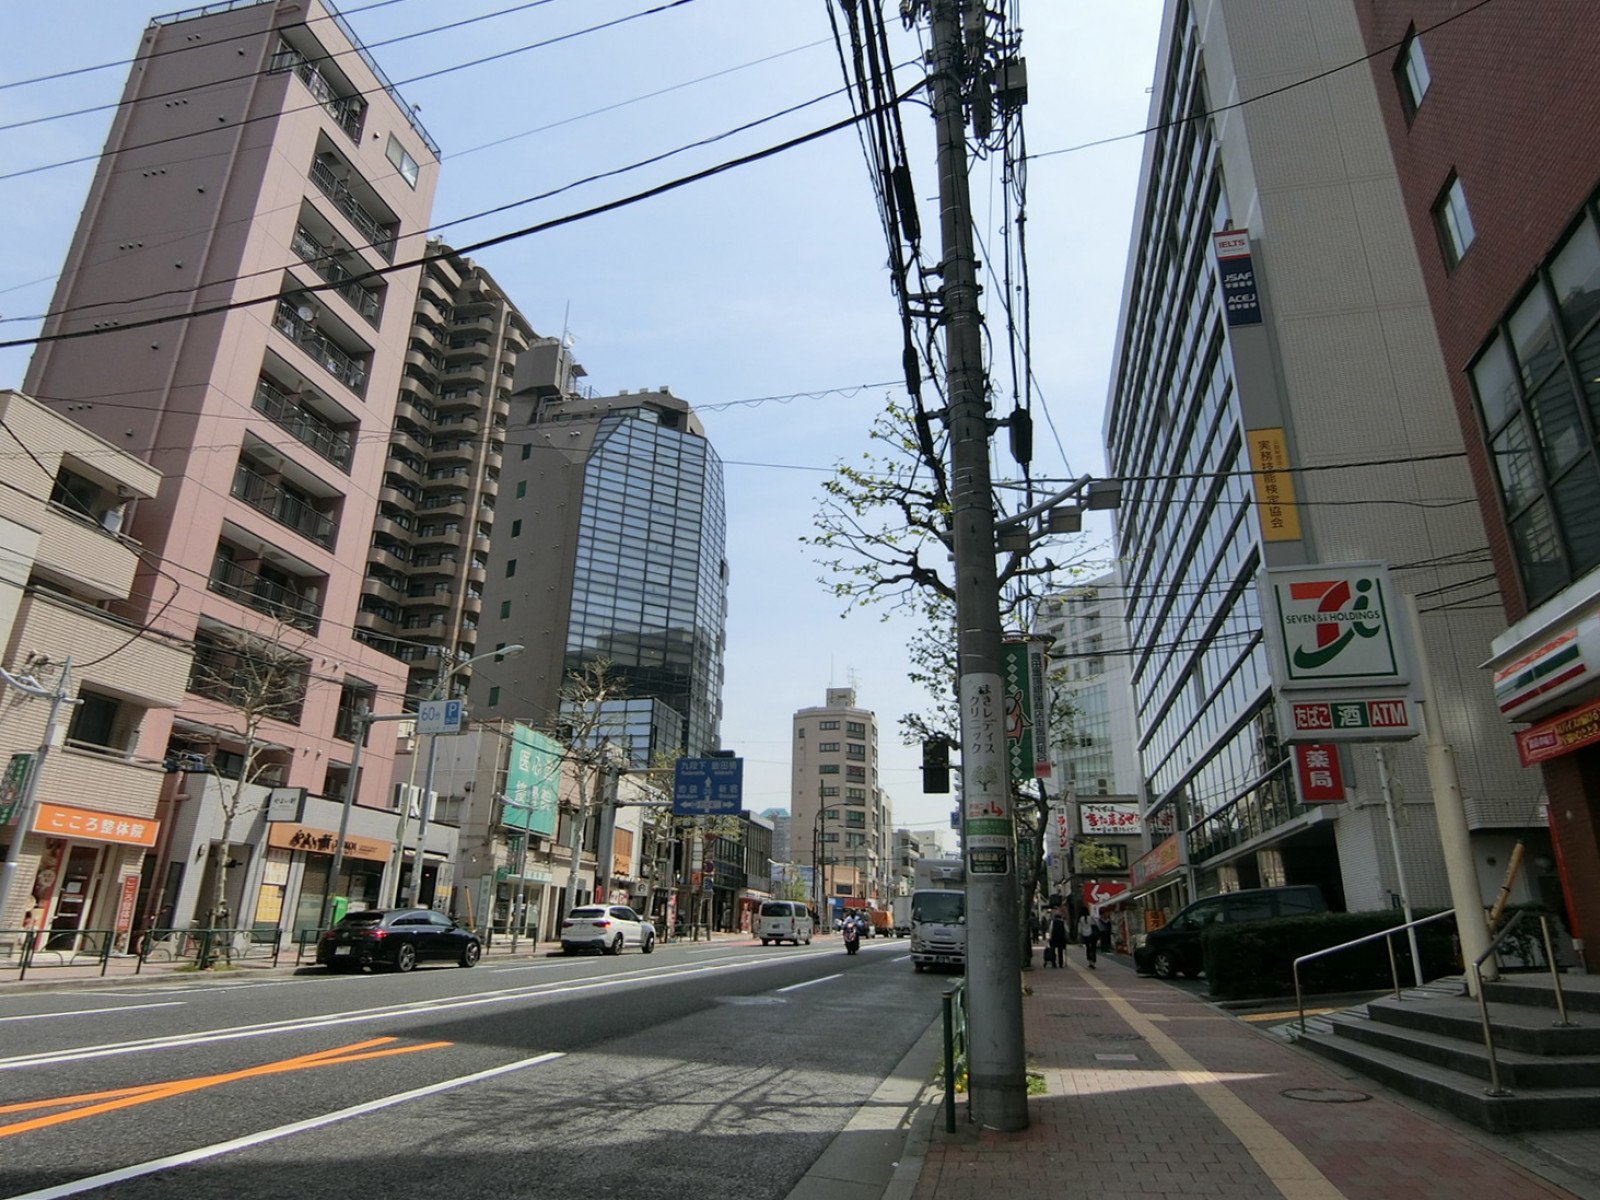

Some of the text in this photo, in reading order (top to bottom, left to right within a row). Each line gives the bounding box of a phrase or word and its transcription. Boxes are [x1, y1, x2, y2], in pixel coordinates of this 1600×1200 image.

[1218, 239, 1246, 249] IELTS
[1223, 271, 1253, 282] JSAF
[1227, 293, 1256, 304] ACEJ
[1258, 440, 1284, 529] 実務技能検定協会
[1329, 609, 1380, 622] HOLDINGS
[969, 696, 982, 754] クリニック
[1296, 704, 1405, 728] たばこ 酒 ATM
[51, 812, 145, 839] こころ整体院
